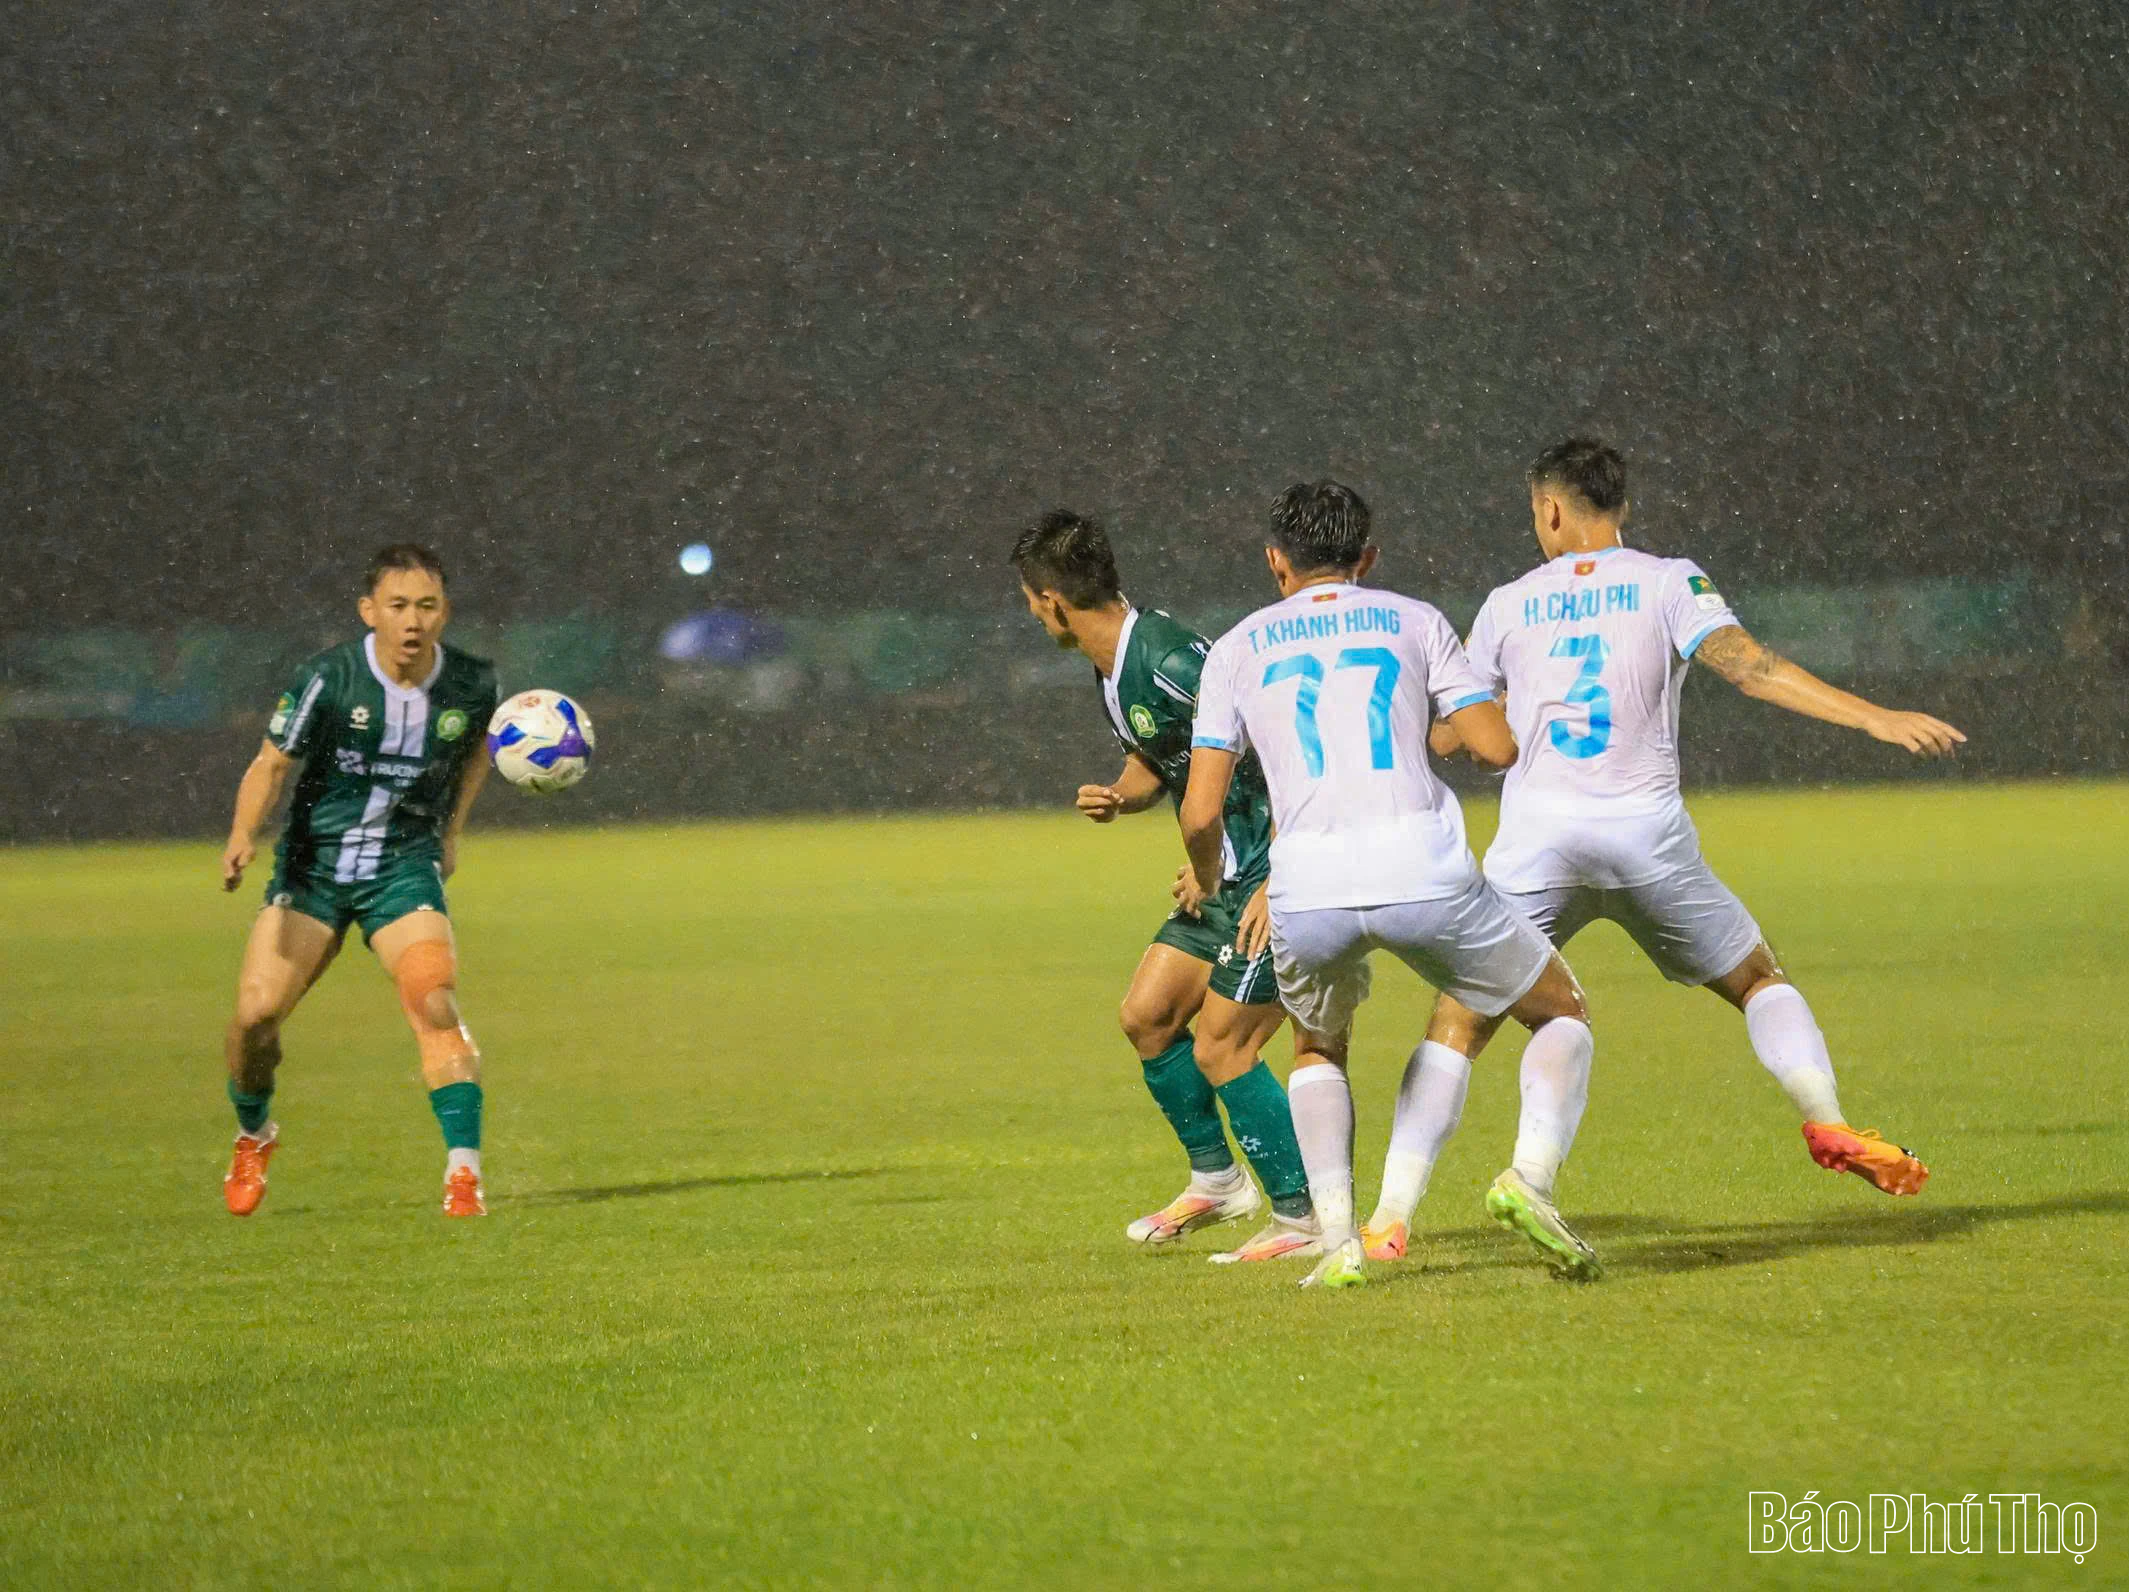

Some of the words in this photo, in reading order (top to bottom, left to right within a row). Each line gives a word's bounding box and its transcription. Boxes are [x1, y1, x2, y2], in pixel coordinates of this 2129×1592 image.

[1248, 613, 1339, 654] T.KHÁNH
[1606, 583, 1640, 613] PHI
[1262, 647, 1401, 779] 77
[1549, 634, 1611, 760] 3
